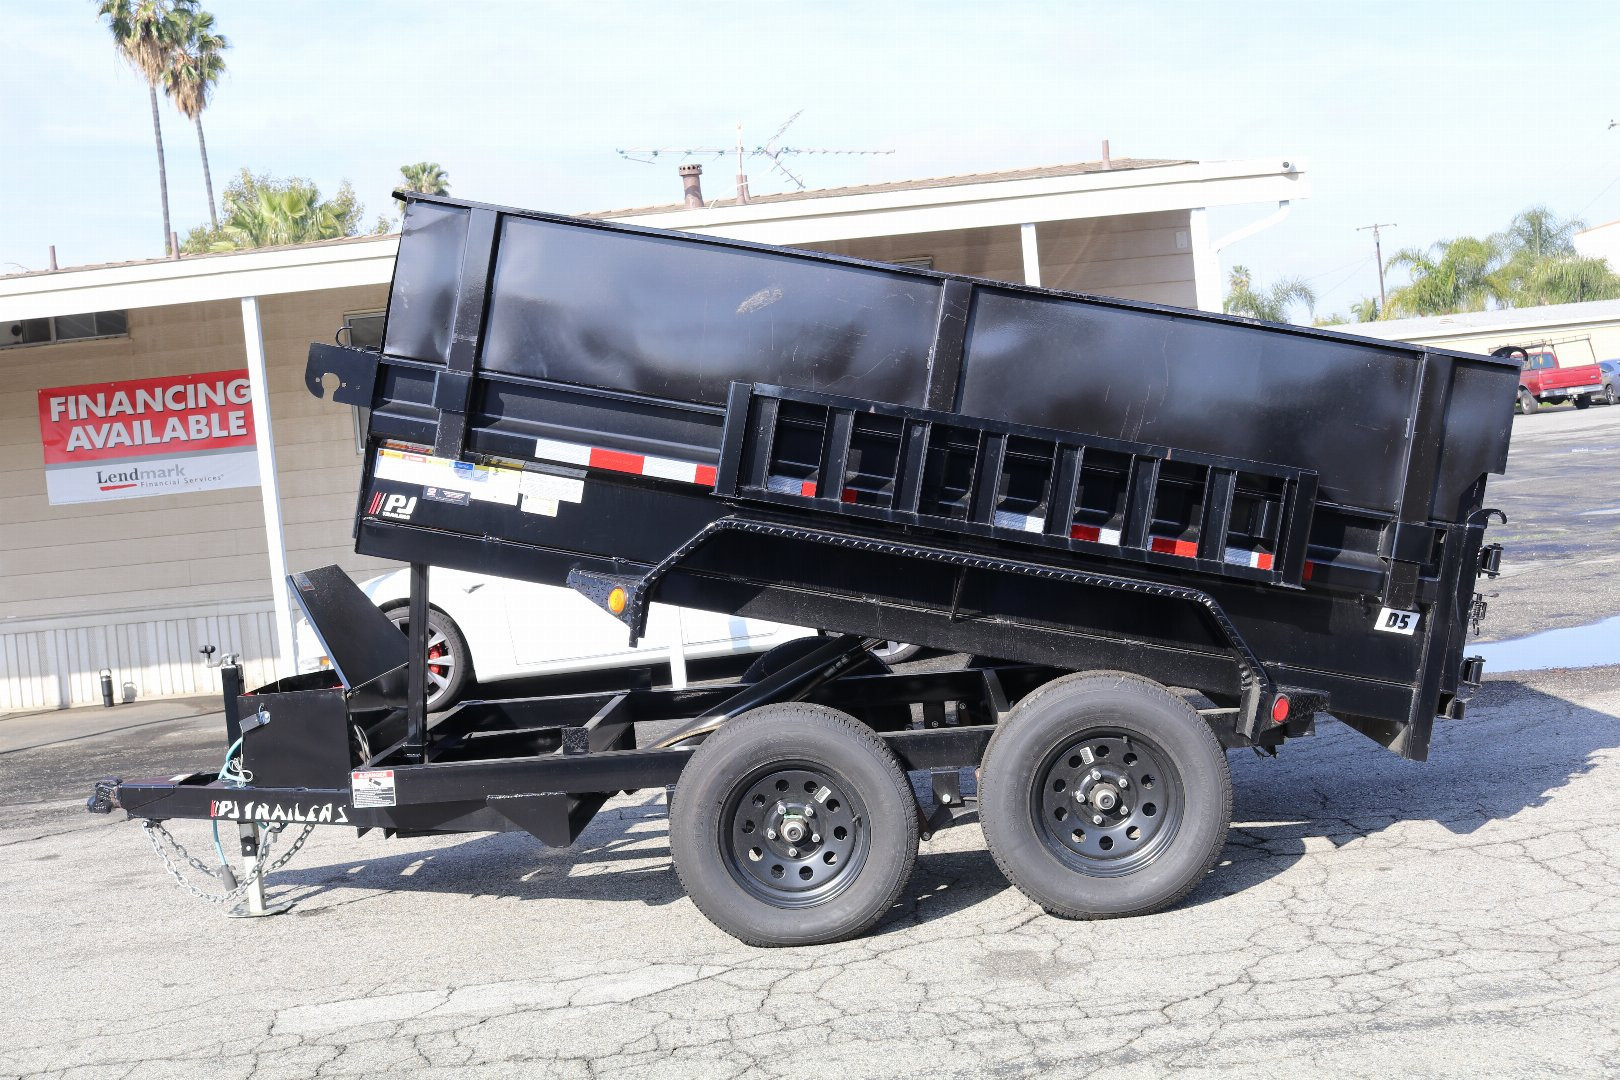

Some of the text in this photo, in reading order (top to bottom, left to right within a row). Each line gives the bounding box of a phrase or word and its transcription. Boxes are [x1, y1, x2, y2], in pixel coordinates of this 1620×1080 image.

[50, 378, 252, 422] FINANCING
[66, 410, 247, 452] AVAILABLE
[96, 464, 186, 484] Lendmark
[140, 475, 223, 487] Financial Services
[383, 494, 417, 514] PJ
[1385, 612, 1411, 630] D5
